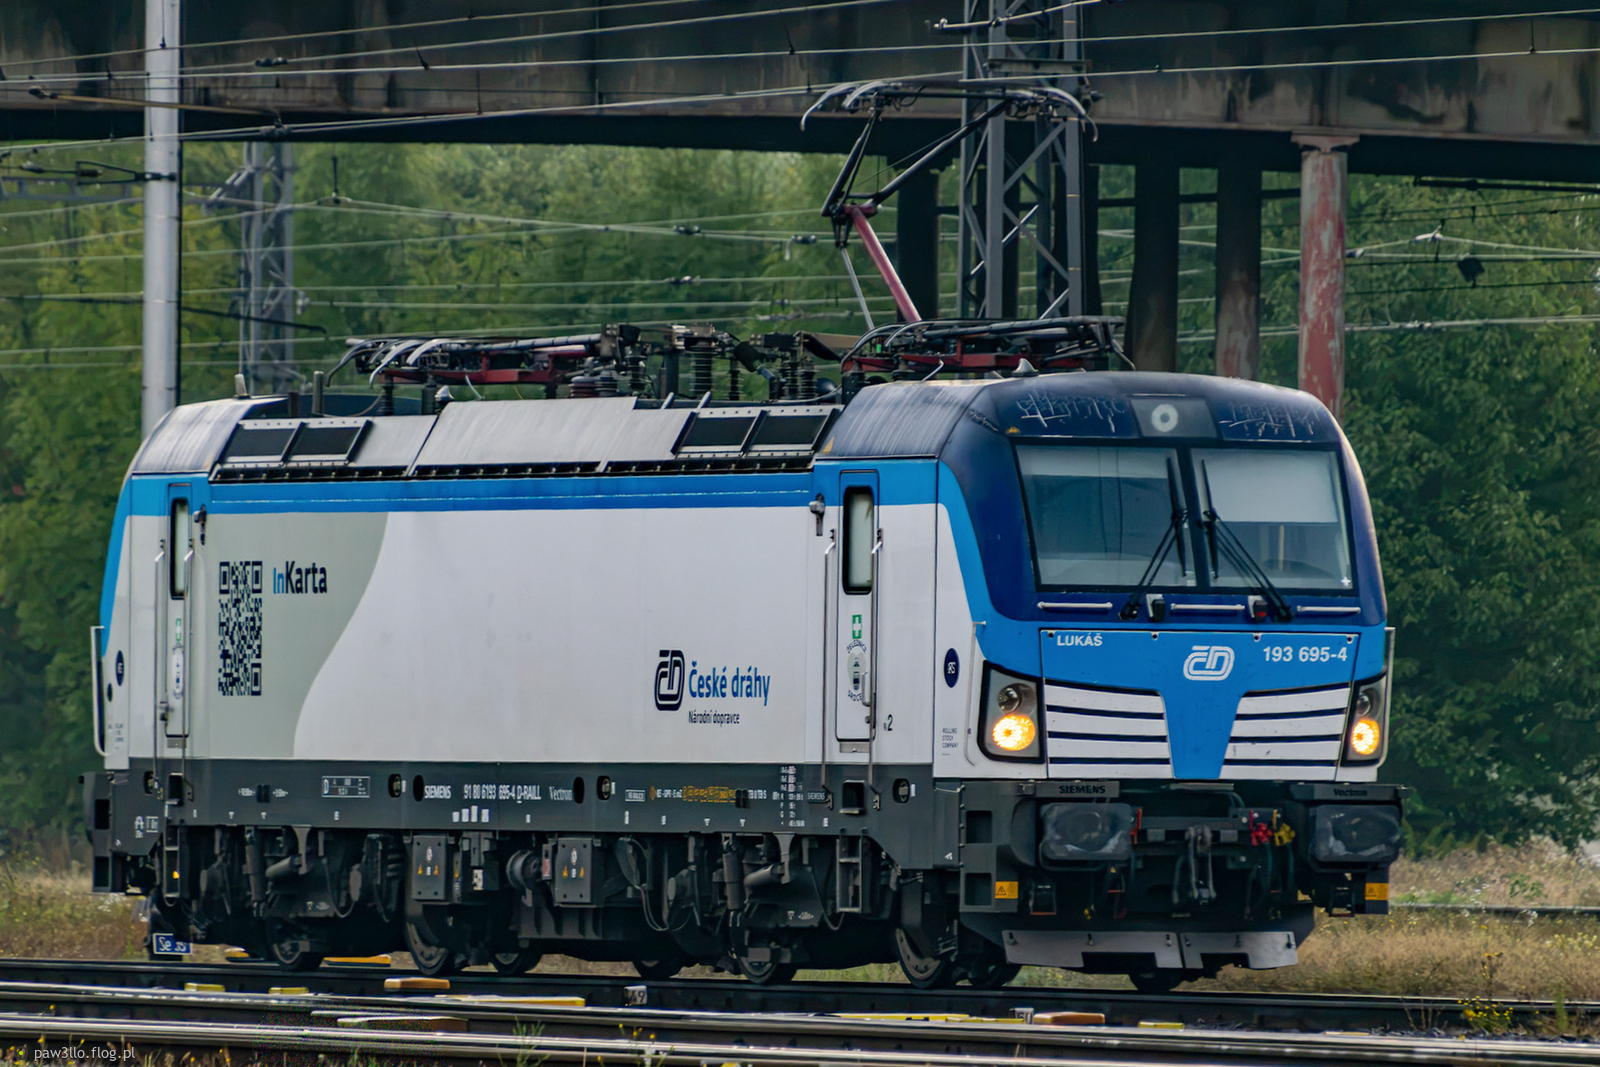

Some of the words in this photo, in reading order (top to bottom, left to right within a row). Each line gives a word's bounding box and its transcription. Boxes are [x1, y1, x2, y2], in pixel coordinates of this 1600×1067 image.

[273, 560, 328, 594] InKarta
[1056, 633, 1103, 647] LUKÁŠ
[1263, 646, 1293, 662] 193
[1298, 646, 1348, 662] 695-4
[688, 660, 728, 698] České
[731, 665, 771, 706] dráhy
[688, 709, 712, 724] Národní
[712, 710, 740, 727] dopravce
[887, 713, 894, 732] 2
[424, 785, 452, 799] SIEMENS
[463, 784, 472, 799] 91
[472, 784, 481, 799] 80
[481, 784, 497, 799] 6193
[498, 785, 516, 800] 695-4
[549, 786, 573, 801] Vectron
[1059, 784, 1106, 794] SIEMENS
